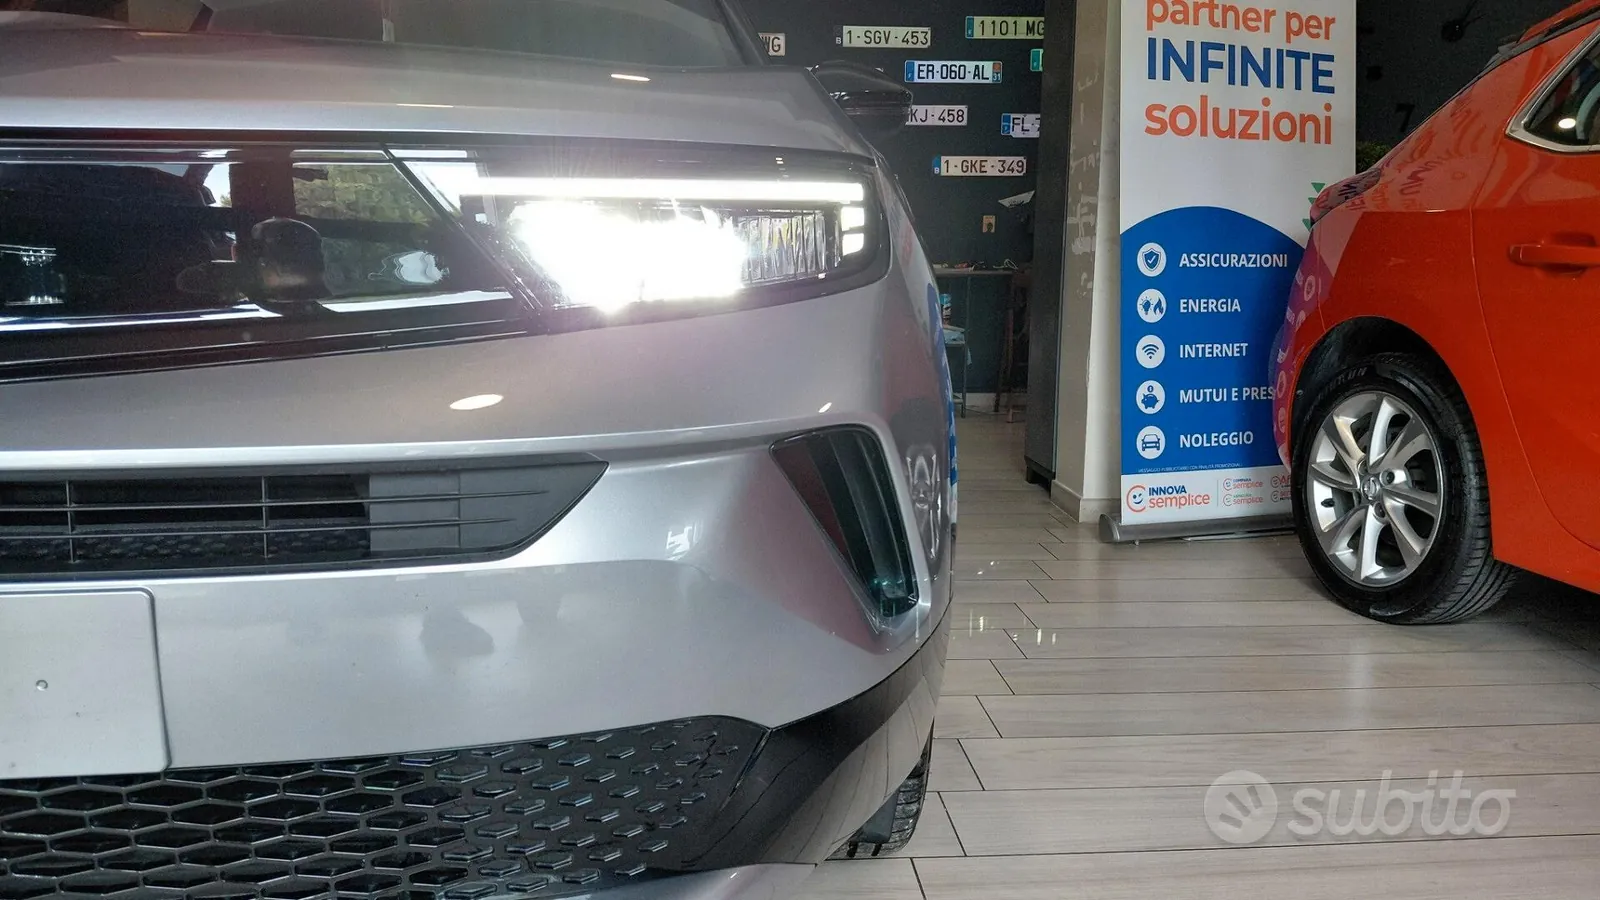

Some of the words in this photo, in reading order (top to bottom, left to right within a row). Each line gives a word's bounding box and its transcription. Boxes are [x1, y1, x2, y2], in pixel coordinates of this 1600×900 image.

[980, 20, 1018, 36] 1101
[1146, 0, 1276, 33] partner
[1285, 11, 1336, 44] per
[1147, 37, 1335, 94] INFINITE
[1144, 95, 1332, 145] soluzioni
[1179, 253, 1288, 268] ASSICURAZIONI
[1180, 298, 1241, 313] ENERGIA
[1180, 343, 1248, 358] INTERNET
[1180, 388, 1227, 404] MUTUI
[1231, 387, 1239, 401] E
[1180, 431, 1254, 449] NOLEGGIO
[1149, 485, 1187, 496] INNOVA
[1149, 492, 1210, 509] semplice
